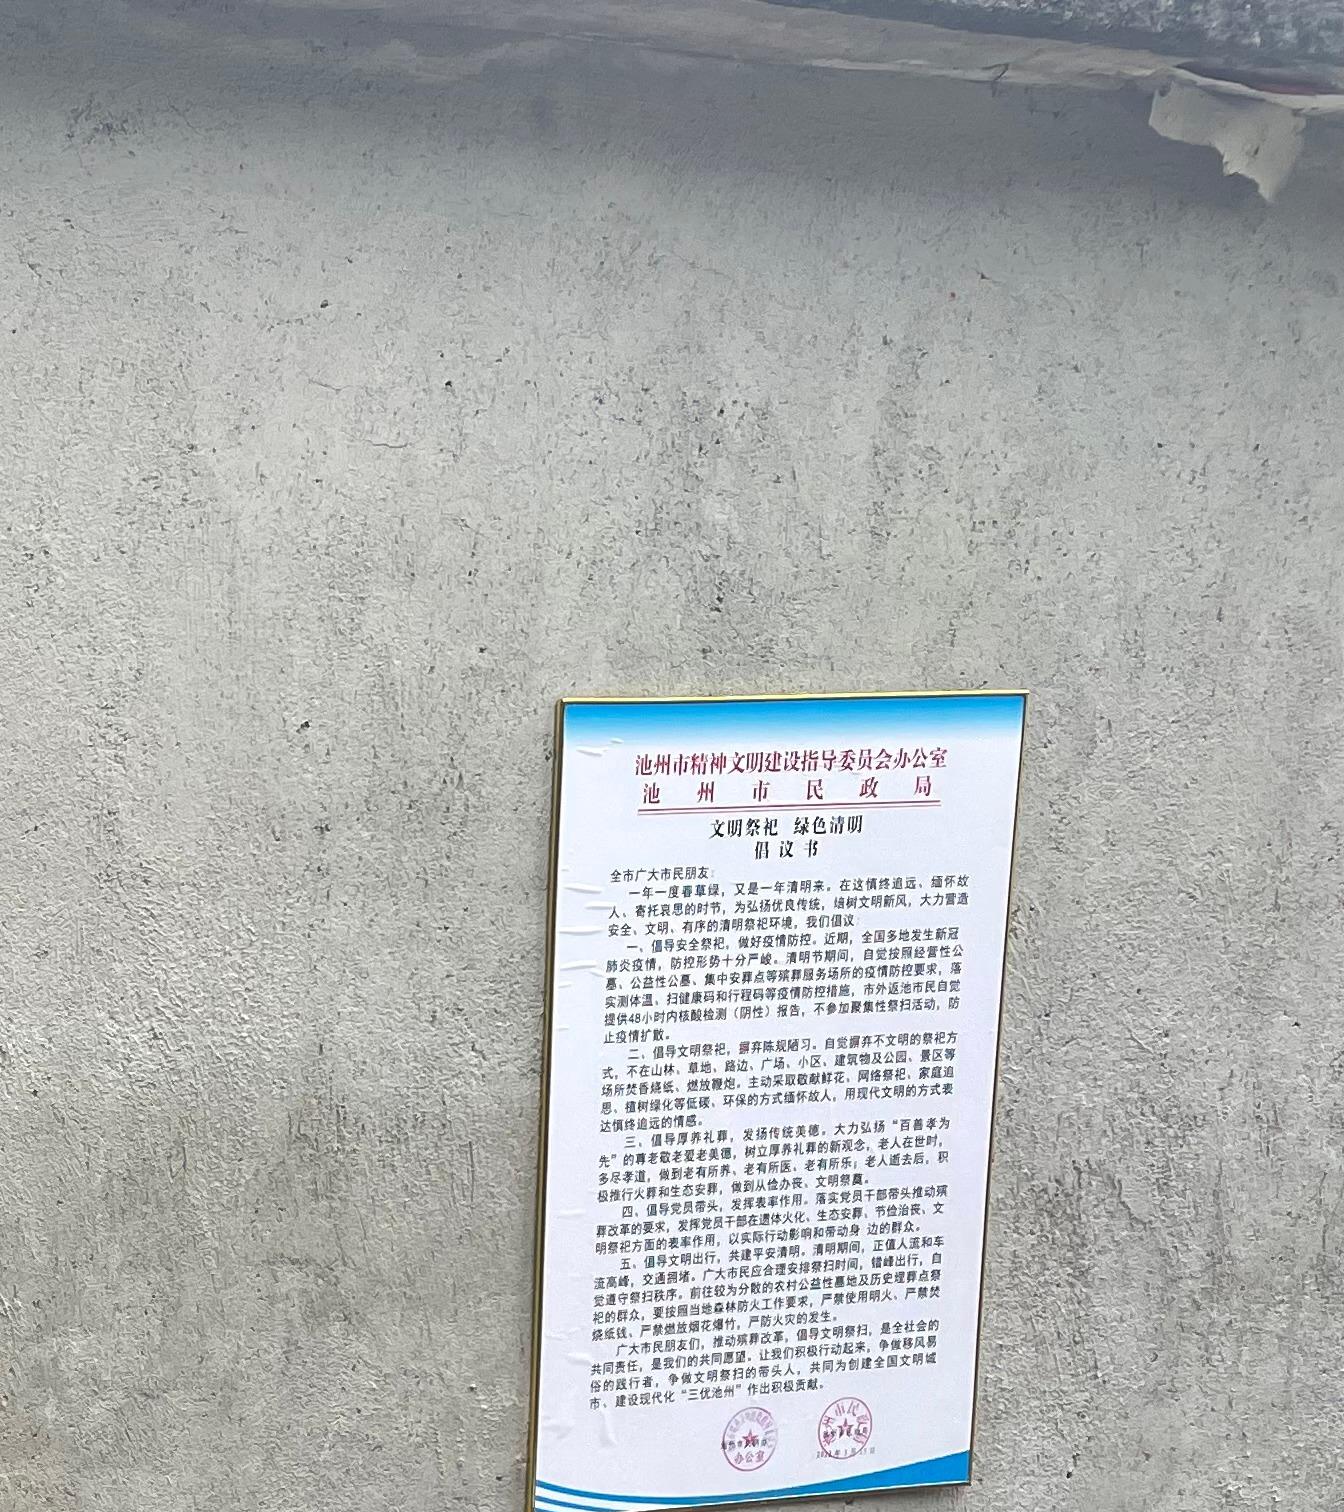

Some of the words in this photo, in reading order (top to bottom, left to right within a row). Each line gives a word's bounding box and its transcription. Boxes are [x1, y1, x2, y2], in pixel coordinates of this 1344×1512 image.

[634, 746, 948, 777] 池州市精神文明建设指导委员会办公室
[642, 775, 932, 805] 池州市民政局
[708, 816, 779, 839] 文明祭祀
[792, 814, 863, 835] 绿色清明
[754, 838, 818, 860] 倡议书
[603, 1027, 670, 1044] 止疫情扩散。
[599, 1113, 703, 1133] 达慎终追远的情感。
